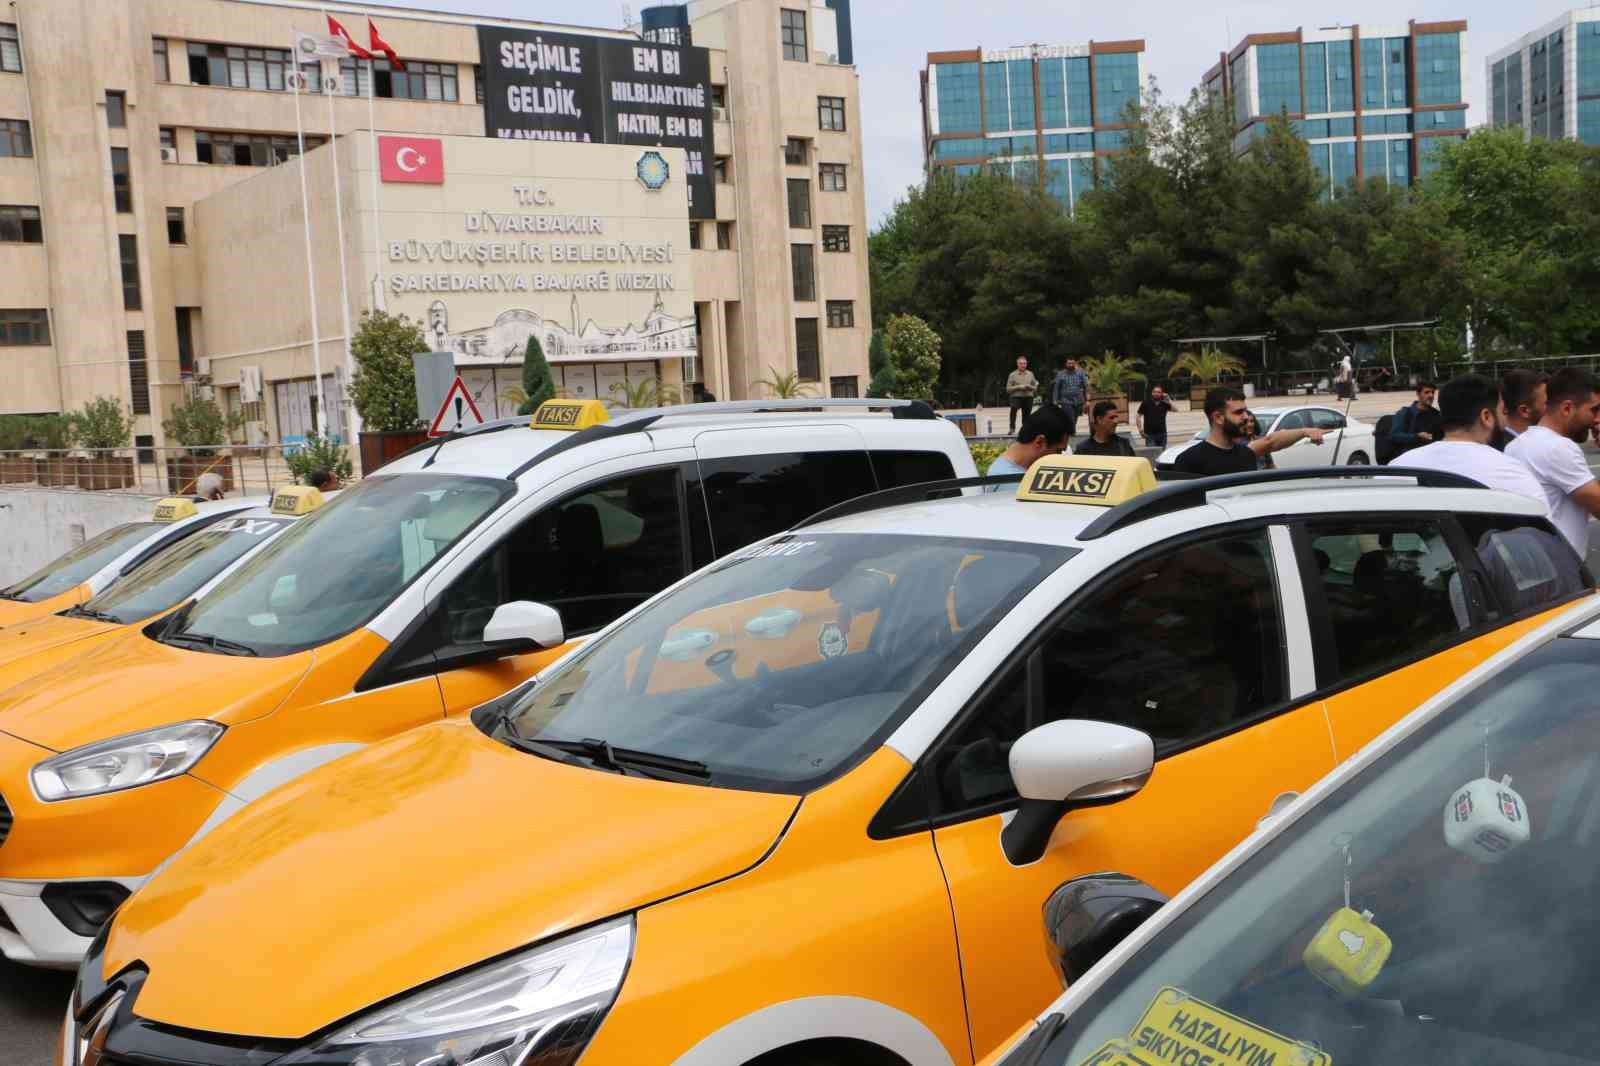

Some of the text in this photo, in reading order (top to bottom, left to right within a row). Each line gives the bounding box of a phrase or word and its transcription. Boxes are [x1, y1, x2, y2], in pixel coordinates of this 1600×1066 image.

[500, 36, 582, 75] SEÇİMLE
[632, 47, 680, 75] EM BI
[507, 81, 582, 119] GELDİK,
[617, 113, 703, 138] HATIN, EM BI
[464, 209, 603, 234] DİYARBAKIR
[389, 239, 673, 267] BÜYÜKŞEHİR BELEDİYESİ
[391, 271, 527, 298] ŞAREDARIYA
[615, 271, 674, 292] MEZIN
[1168, 1010, 1277, 1066] HATALIYIM
